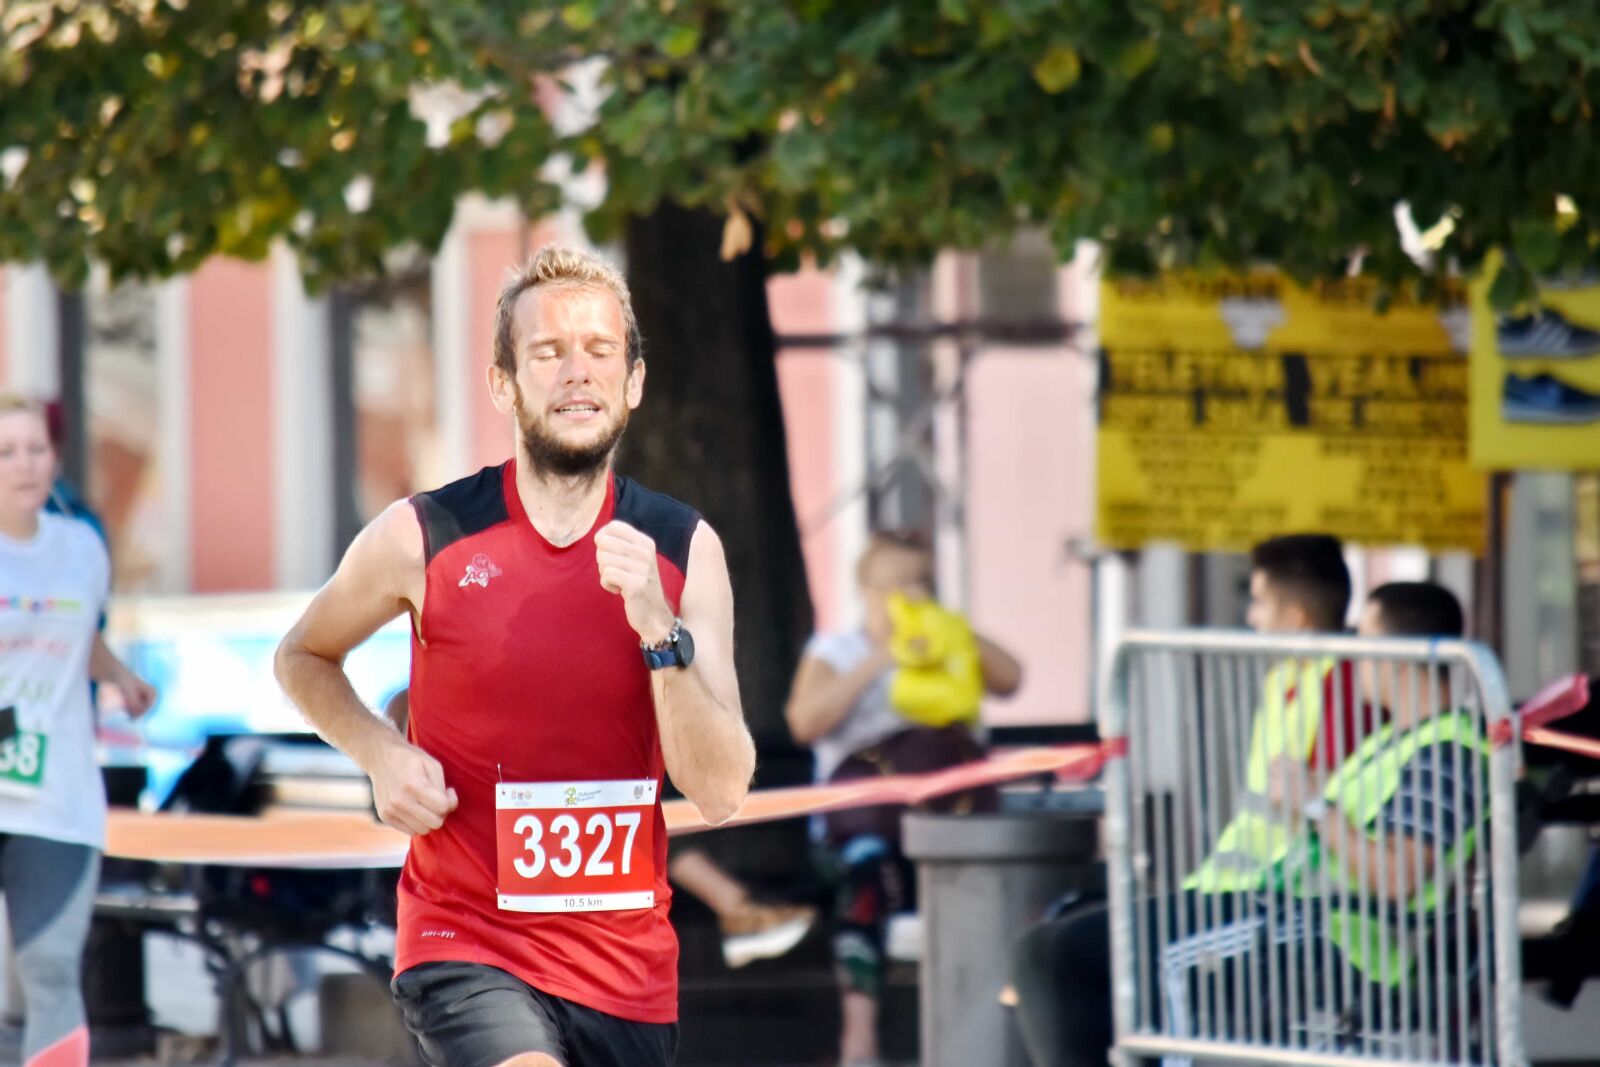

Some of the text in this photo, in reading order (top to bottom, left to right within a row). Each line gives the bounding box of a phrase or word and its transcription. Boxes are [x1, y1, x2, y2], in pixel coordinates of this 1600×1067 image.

[513, 813, 641, 878] 3327
[564, 899, 603, 907] 10.5 km
